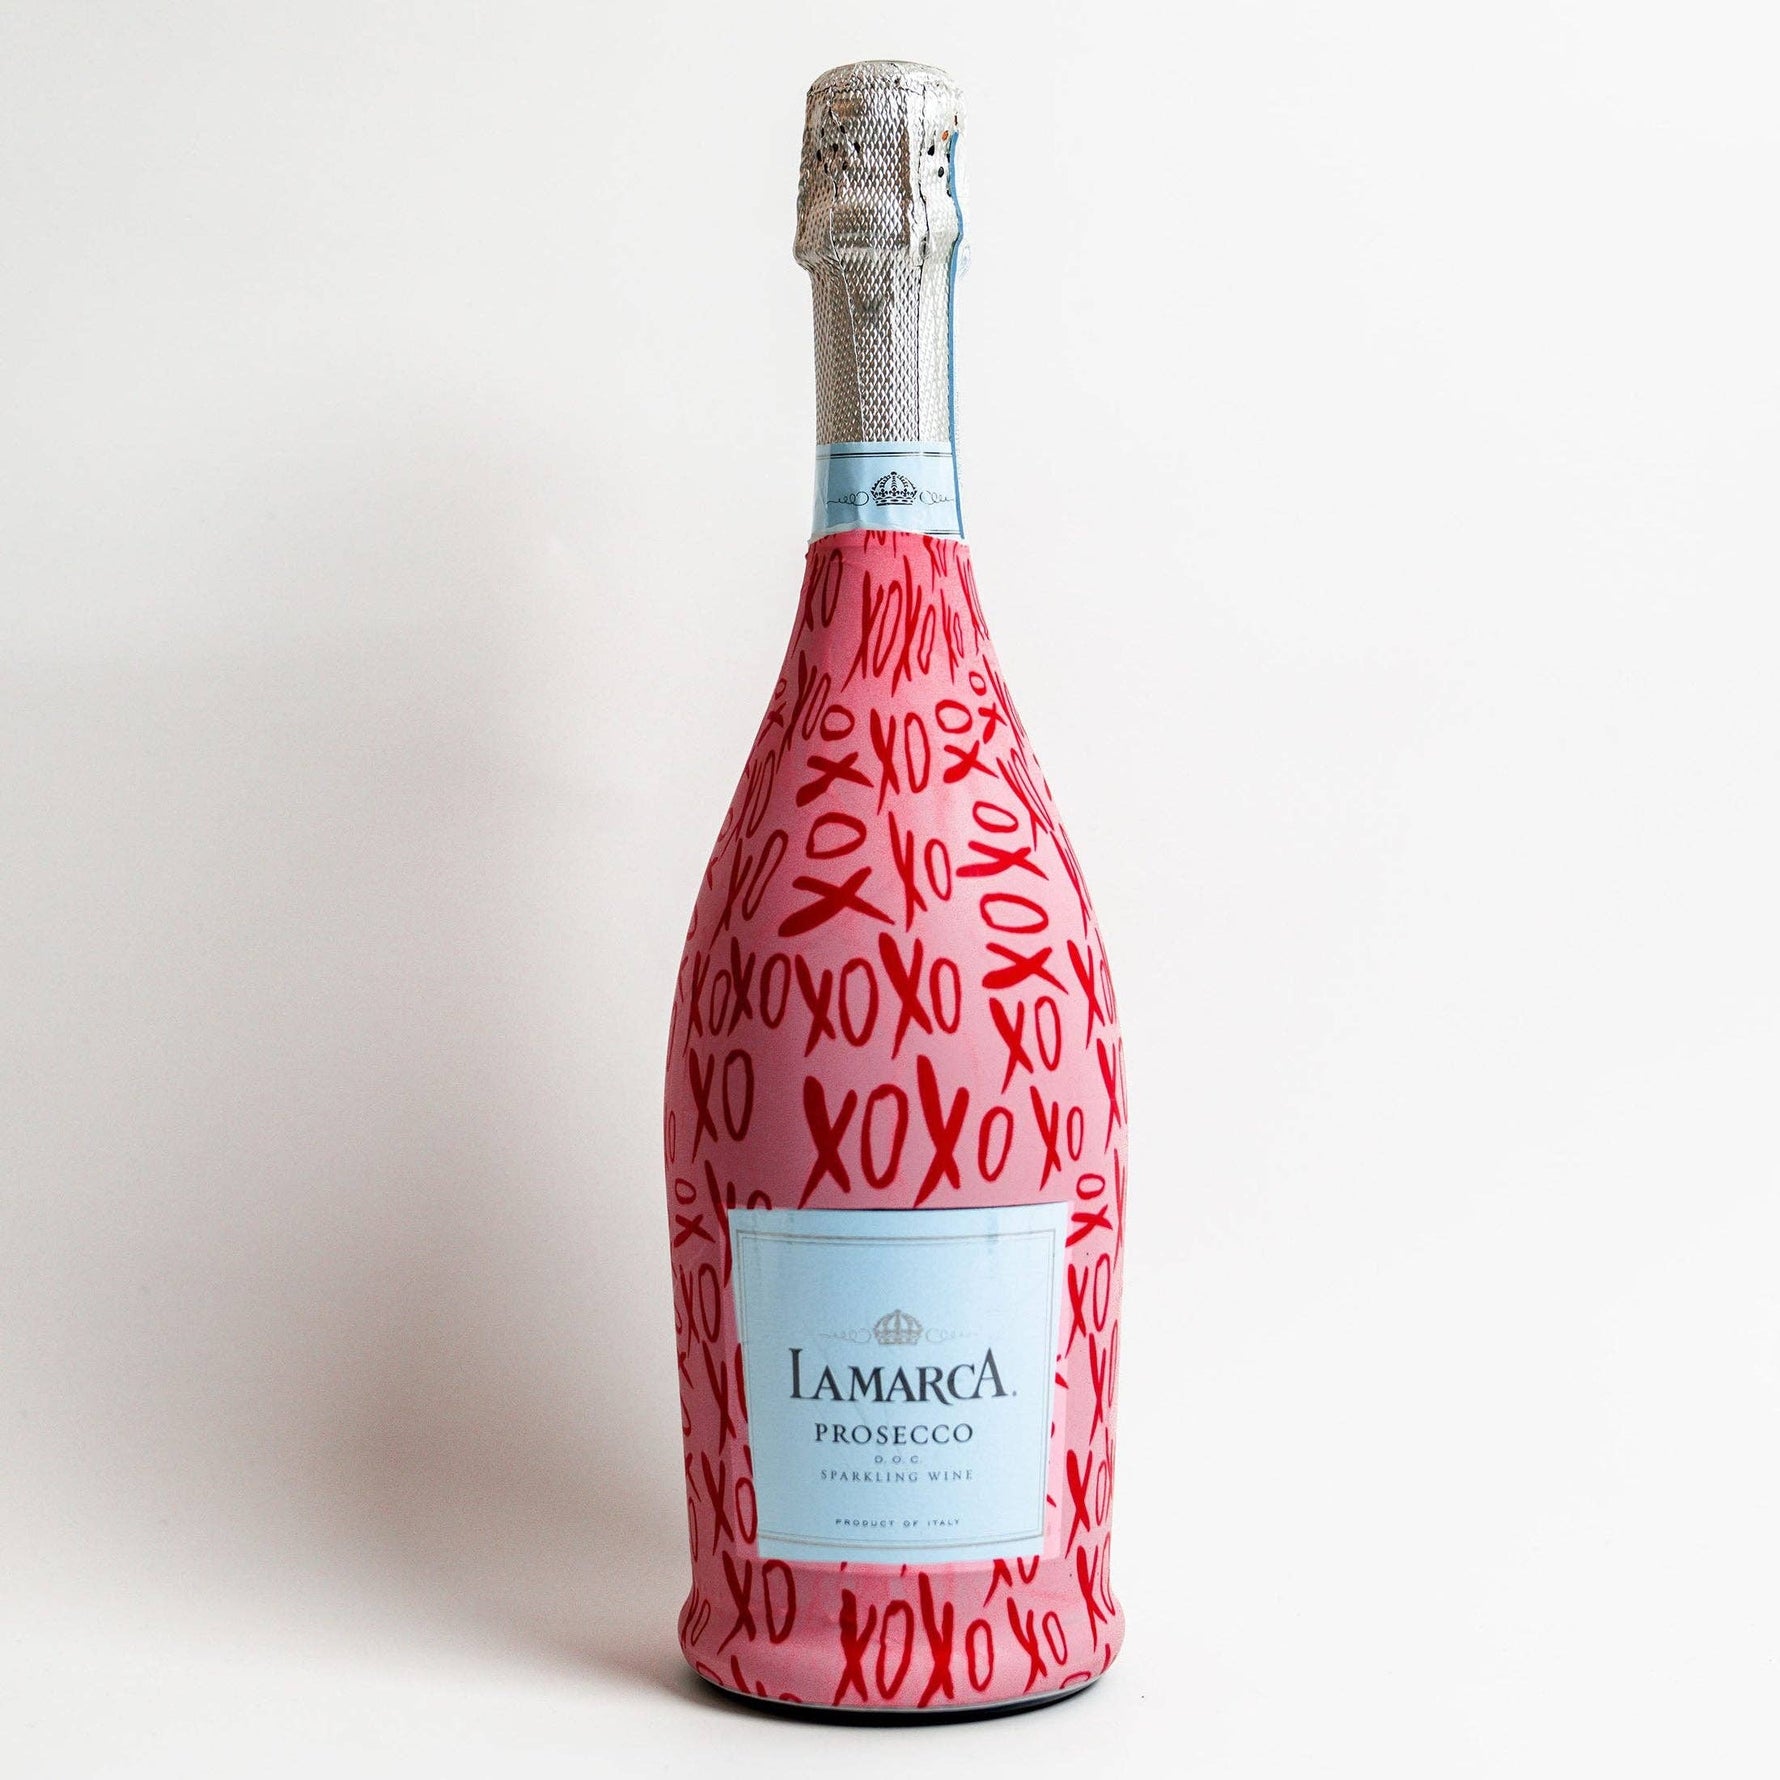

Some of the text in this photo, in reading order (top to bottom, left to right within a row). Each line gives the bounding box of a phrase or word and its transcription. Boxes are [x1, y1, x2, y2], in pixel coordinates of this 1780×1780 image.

[815, 1422, 973, 1446] PROSECCO
[820, 1469, 973, 1483] SPARKLING WINE
[835, 1518, 960, 1528] PRODUCT OF ITALY
